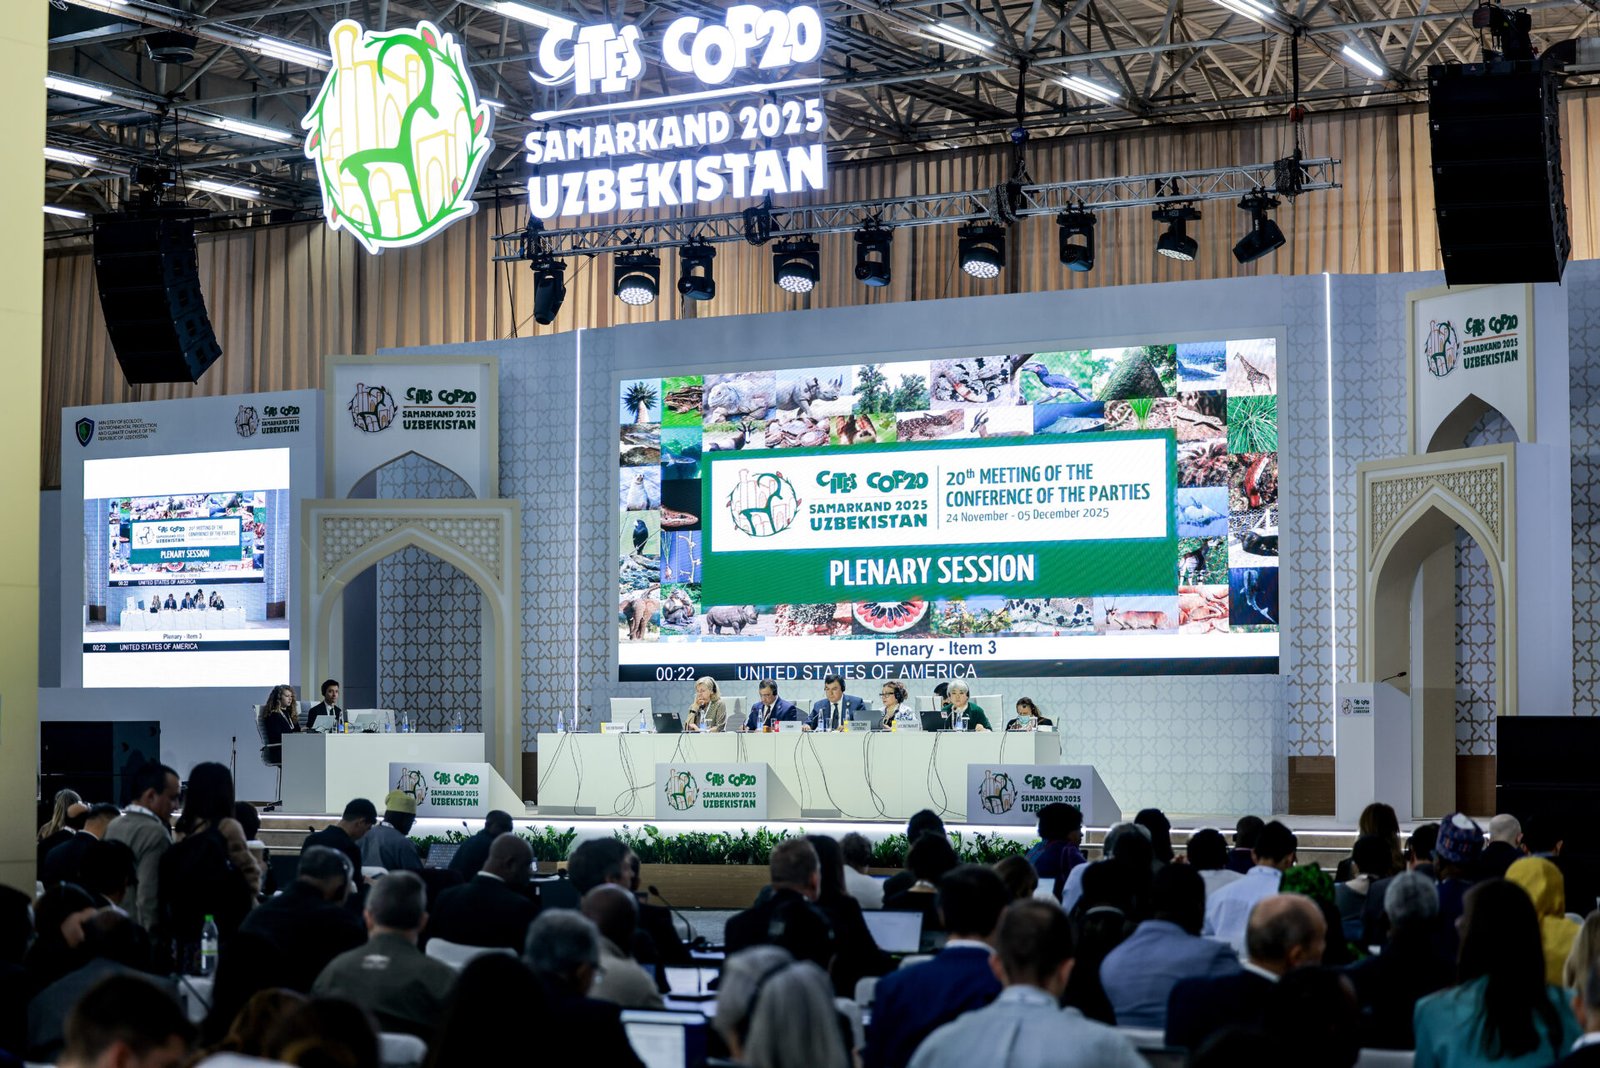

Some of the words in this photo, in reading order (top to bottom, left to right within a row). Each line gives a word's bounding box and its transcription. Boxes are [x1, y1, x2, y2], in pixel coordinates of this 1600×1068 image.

[529, 23, 643, 95] CITES
[524, 110, 730, 164] SAMARKAND
[739, 98, 824, 140] 2025
[527, 144, 826, 219] UZBEKISTAN
[1463, 341, 1501, 355] SAMARKAND
[1463, 350, 1518, 369] UZBEKISTAN
[402, 410, 454, 418] SAMARKAND
[456, 410, 476, 418] 2025
[261, 425, 300, 435] UZBEKISTAN
[403, 420, 476, 430] UZBEKISTAN
[816, 470, 857, 494] CITES
[946, 467, 975, 486] 20th
[979, 465, 1041, 485] MEETING
[1044, 464, 1063, 482] OF
[1066, 463, 1094, 481] THE
[946, 487, 1033, 508] CONFERENCE
[1036, 487, 1055, 505] OF
[1058, 485, 1086, 504] THE
[1088, 482, 1151, 502] PARTIES
[809, 501, 892, 515] SAMARKAND
[895, 499, 928, 511] 2025
[946, 513, 959, 523] 24
[961, 511, 1008, 523] November
[1017, 510, 1031, 521] 05
[1032, 508, 1080, 520] December
[1083, 507, 1110, 519] 2025
[809, 513, 928, 531] UZBEKISTAN
[160, 550, 185, 559] PLENARY
[186, 549, 210, 558] SESSION
[829, 556, 932, 587] PLENARY
[937, 553, 1035, 584] SESSION
[875, 642, 934, 659] Plenary
[949, 641, 983, 656] Item
[987, 640, 997, 654] 3
[655, 666, 695, 682] 00:22
[738, 665, 798, 681] UNITED
[802, 663, 866, 680] STATES
[871, 664, 894, 679] OF
[898, 663, 977, 679] AMERICA
[431, 798, 479, 806] UZBEKISTAN
[703, 799, 756, 809] UZBEKISTAN
[1021, 795, 1063, 803] SAMARKAND
[1064, 795, 1081, 803] 2025
